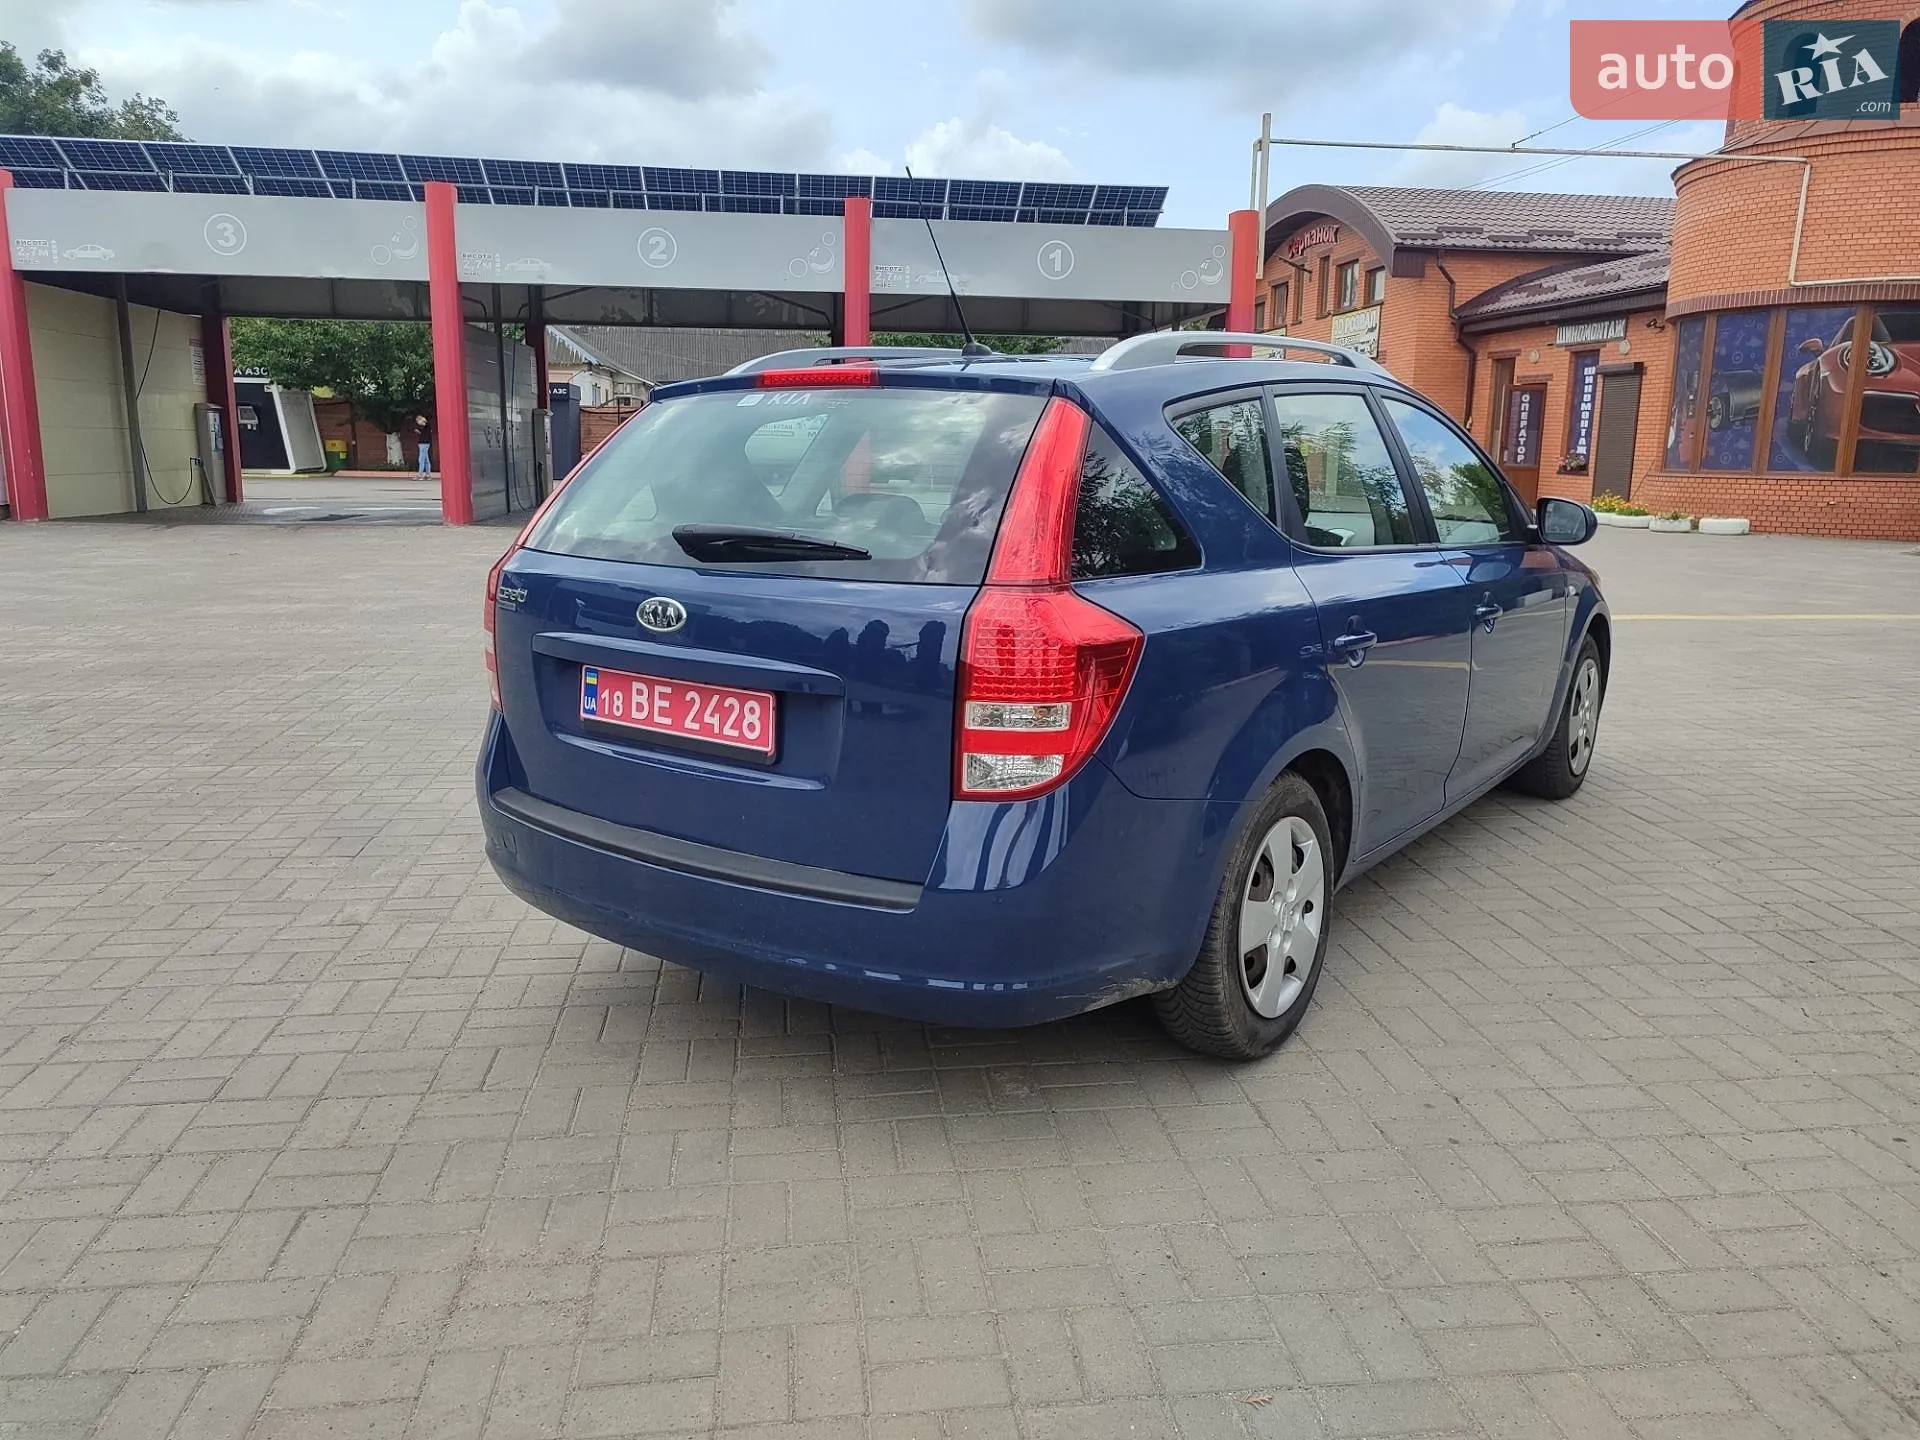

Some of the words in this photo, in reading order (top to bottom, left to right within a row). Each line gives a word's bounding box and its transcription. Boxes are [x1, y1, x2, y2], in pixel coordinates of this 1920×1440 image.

[217, 222, 236, 247] 3
[648, 236, 668, 260] 2
[1049, 249, 1062, 271] 1
[1556, 319, 1626, 344] ШИНОМОНТАЖ
[767, 393, 812, 405] KIA
[1575, 366, 1596, 455] ШИНОМОНТАЖ
[1517, 394, 1530, 462] ОПЕРАТОР
[585, 696, 597, 711] UA
[601, 688, 623, 717] 18
[631, 681, 673, 725] BE
[684, 690, 761, 740] 2428
